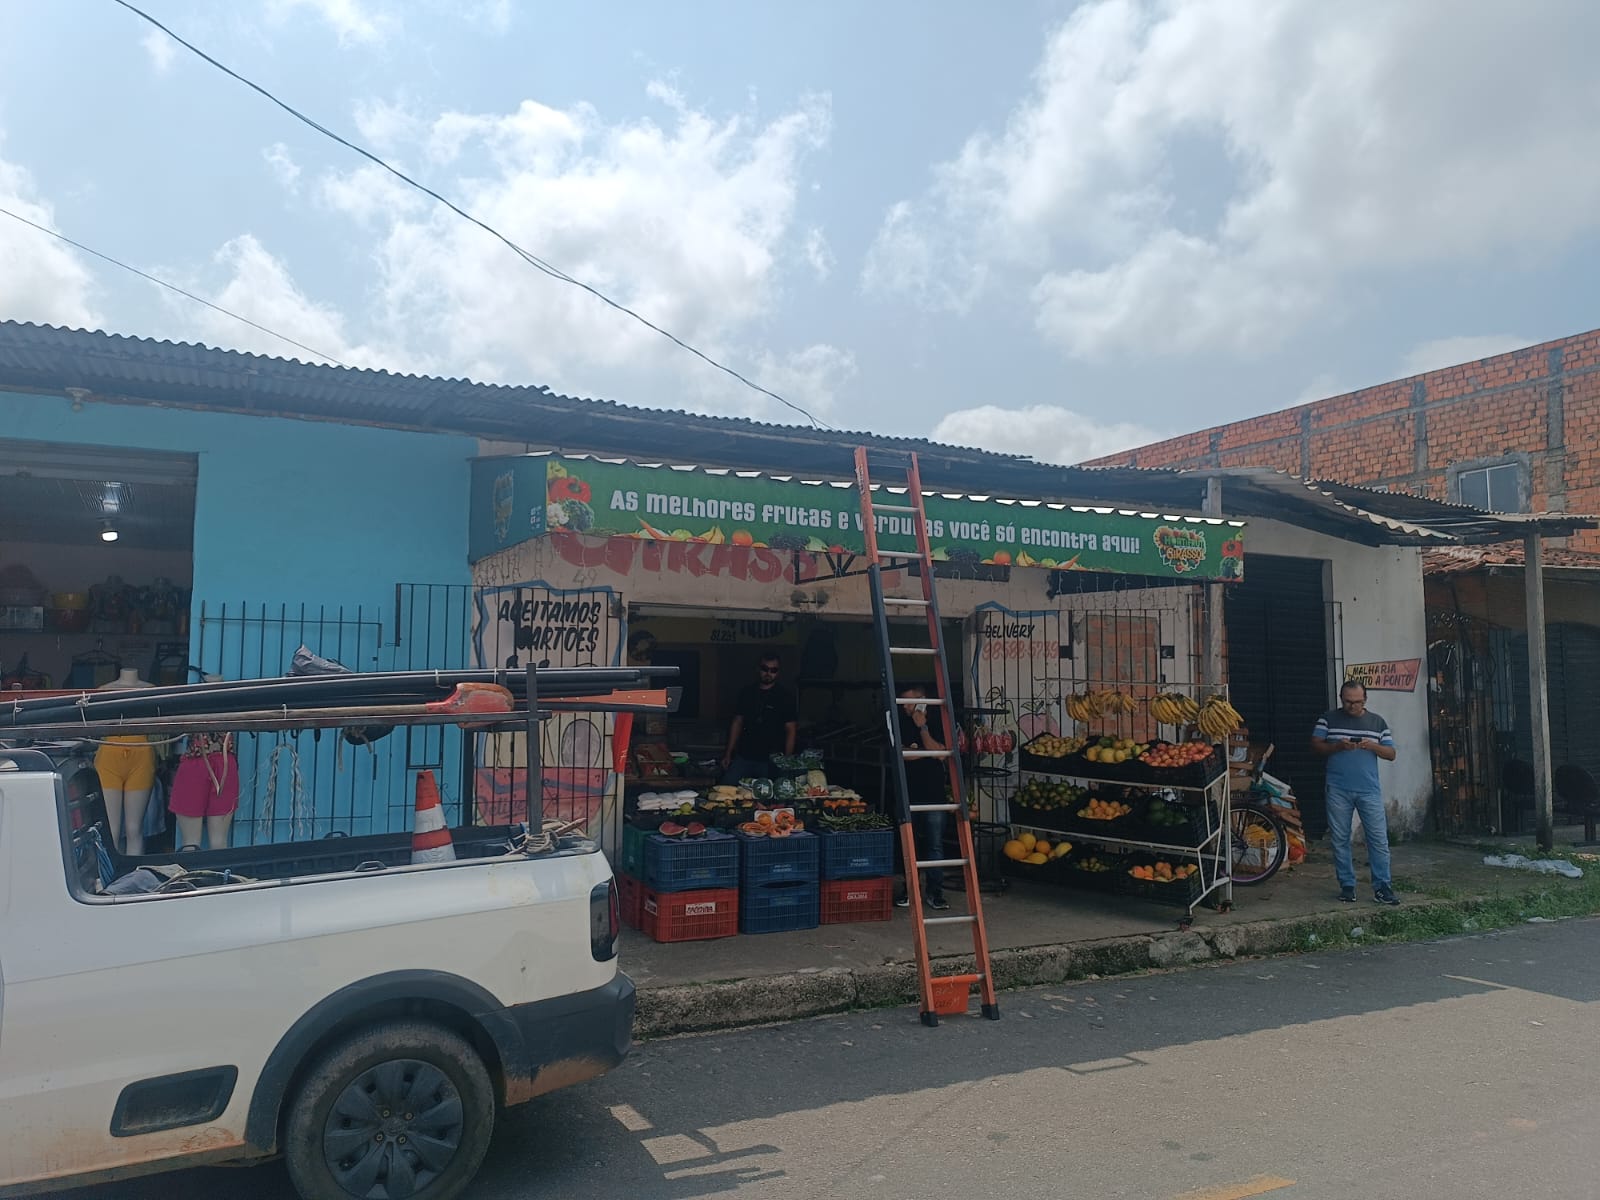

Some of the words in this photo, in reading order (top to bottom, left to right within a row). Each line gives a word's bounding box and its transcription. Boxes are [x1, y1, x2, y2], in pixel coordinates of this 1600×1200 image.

[762, 504, 832, 529] frutas
[838, 511, 849, 530] e
[855, 512, 944, 538] vrduas
[949, 520, 990, 541] você
[995, 522, 1015, 543] só
[1021, 527, 1097, 551] encontra
[1102, 534, 1140, 554] aqui!
[498, 600, 601, 624] ACEITAMOS
[985, 622, 1035, 639] DELIVERY
[1353, 664, 1397, 675] MALHARIA
[1375, 675, 1382, 687] A
[1383, 674, 1411, 687] PONTO
